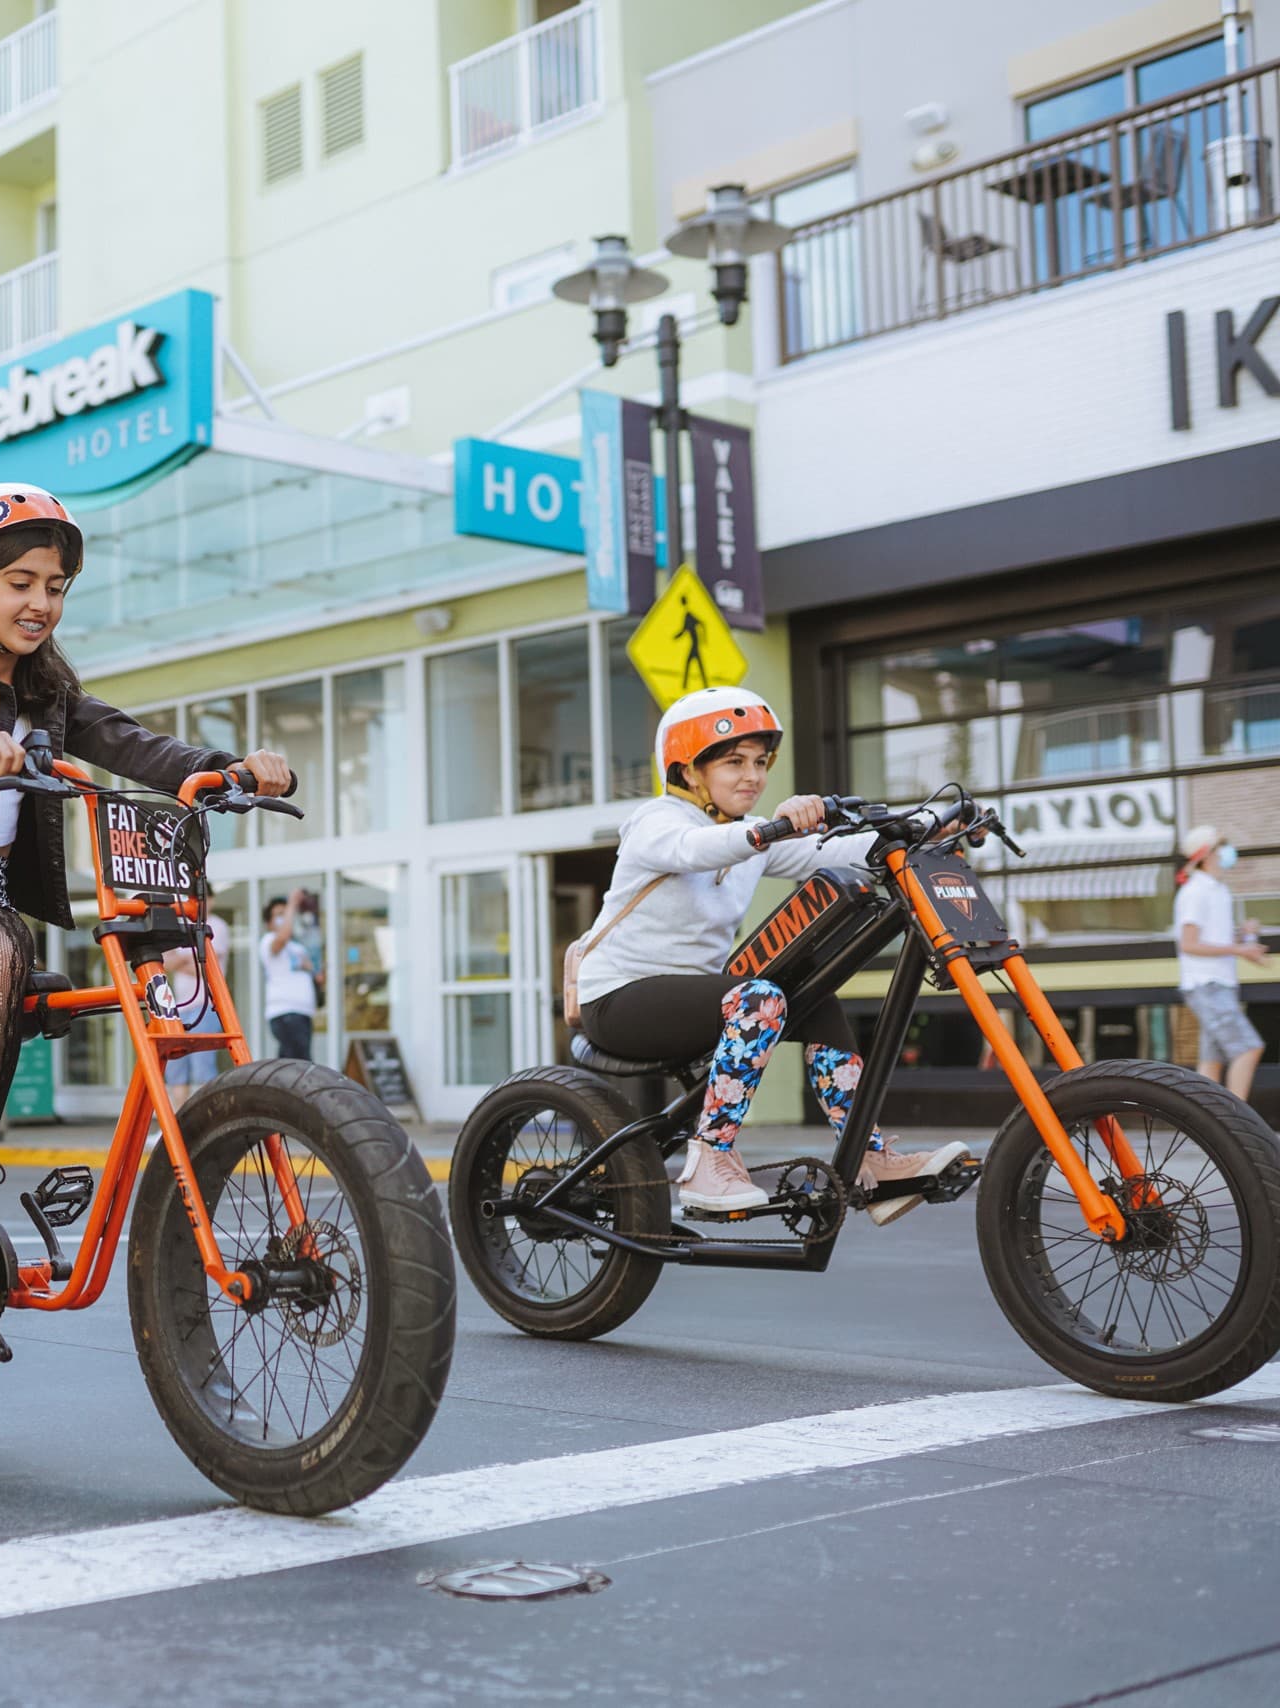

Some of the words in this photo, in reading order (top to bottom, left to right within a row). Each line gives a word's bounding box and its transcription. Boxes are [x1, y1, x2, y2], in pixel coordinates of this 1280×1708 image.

[1167, 296, 1280, 431] IK
[68, 407, 174, 466] HOTEL
[712, 439, 735, 569] VALET
[107, 803, 138, 830] FAT
[109, 831, 148, 857] BIKE
[111, 856, 191, 889] RENTALS
